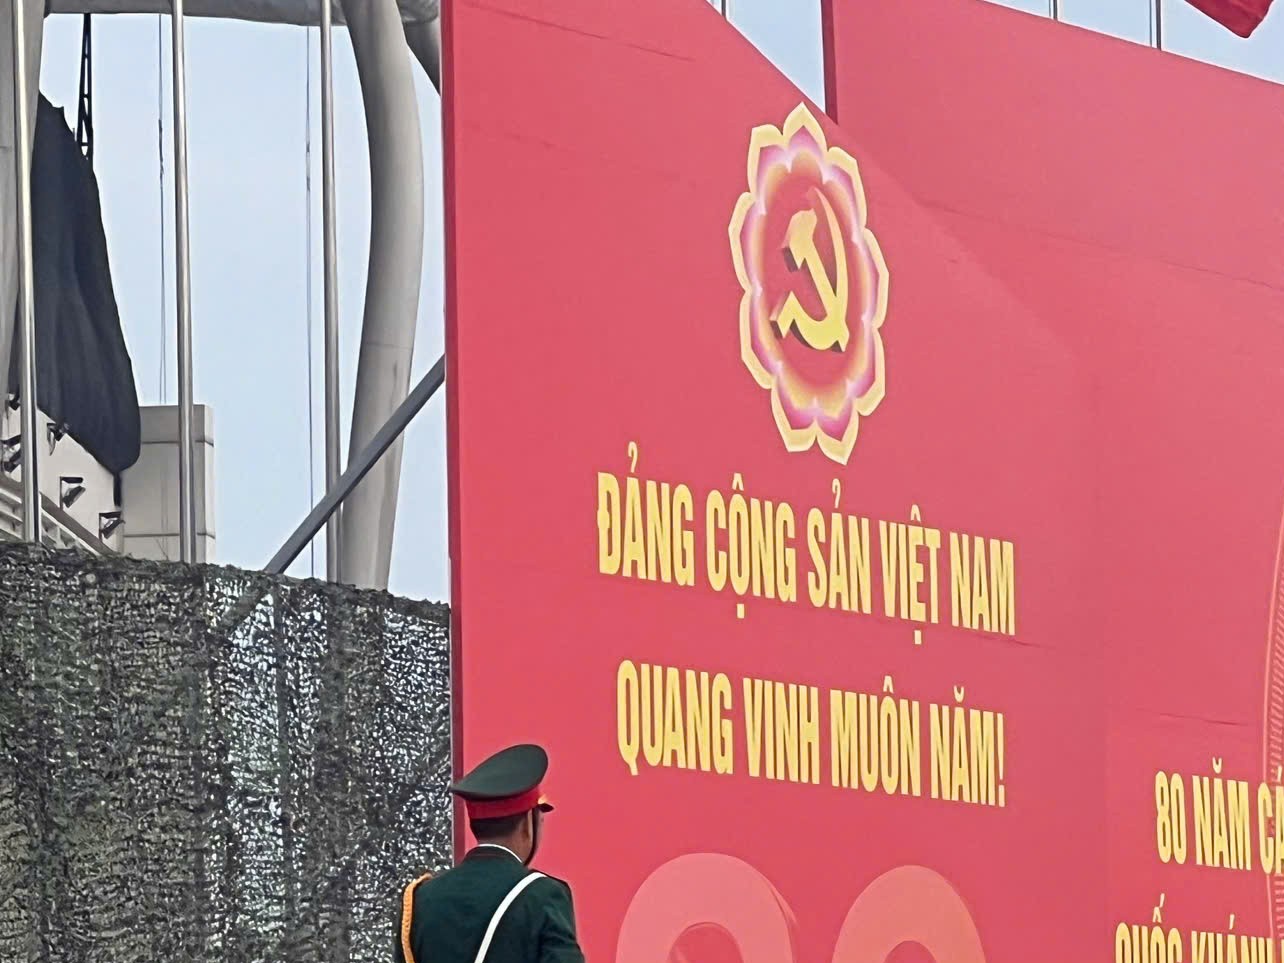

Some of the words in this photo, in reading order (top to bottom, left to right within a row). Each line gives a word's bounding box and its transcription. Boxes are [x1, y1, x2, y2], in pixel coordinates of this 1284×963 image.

[597, 441, 695, 586] ĐẢNG
[706, 473, 797, 618] CỘNG
[807, 478, 871, 614] SẢN
[879, 504, 941, 645] VIỆT
[950, 532, 1015, 635] NAM
[617, 660, 733, 776] QUANG
[743, 677, 820, 785] VINH
[830, 675, 921, 797] MUÔN
[930, 686, 1005, 808] NĂM!
[1155, 771, 1187, 864] 80
[1192, 757, 1251, 870] NĂM
